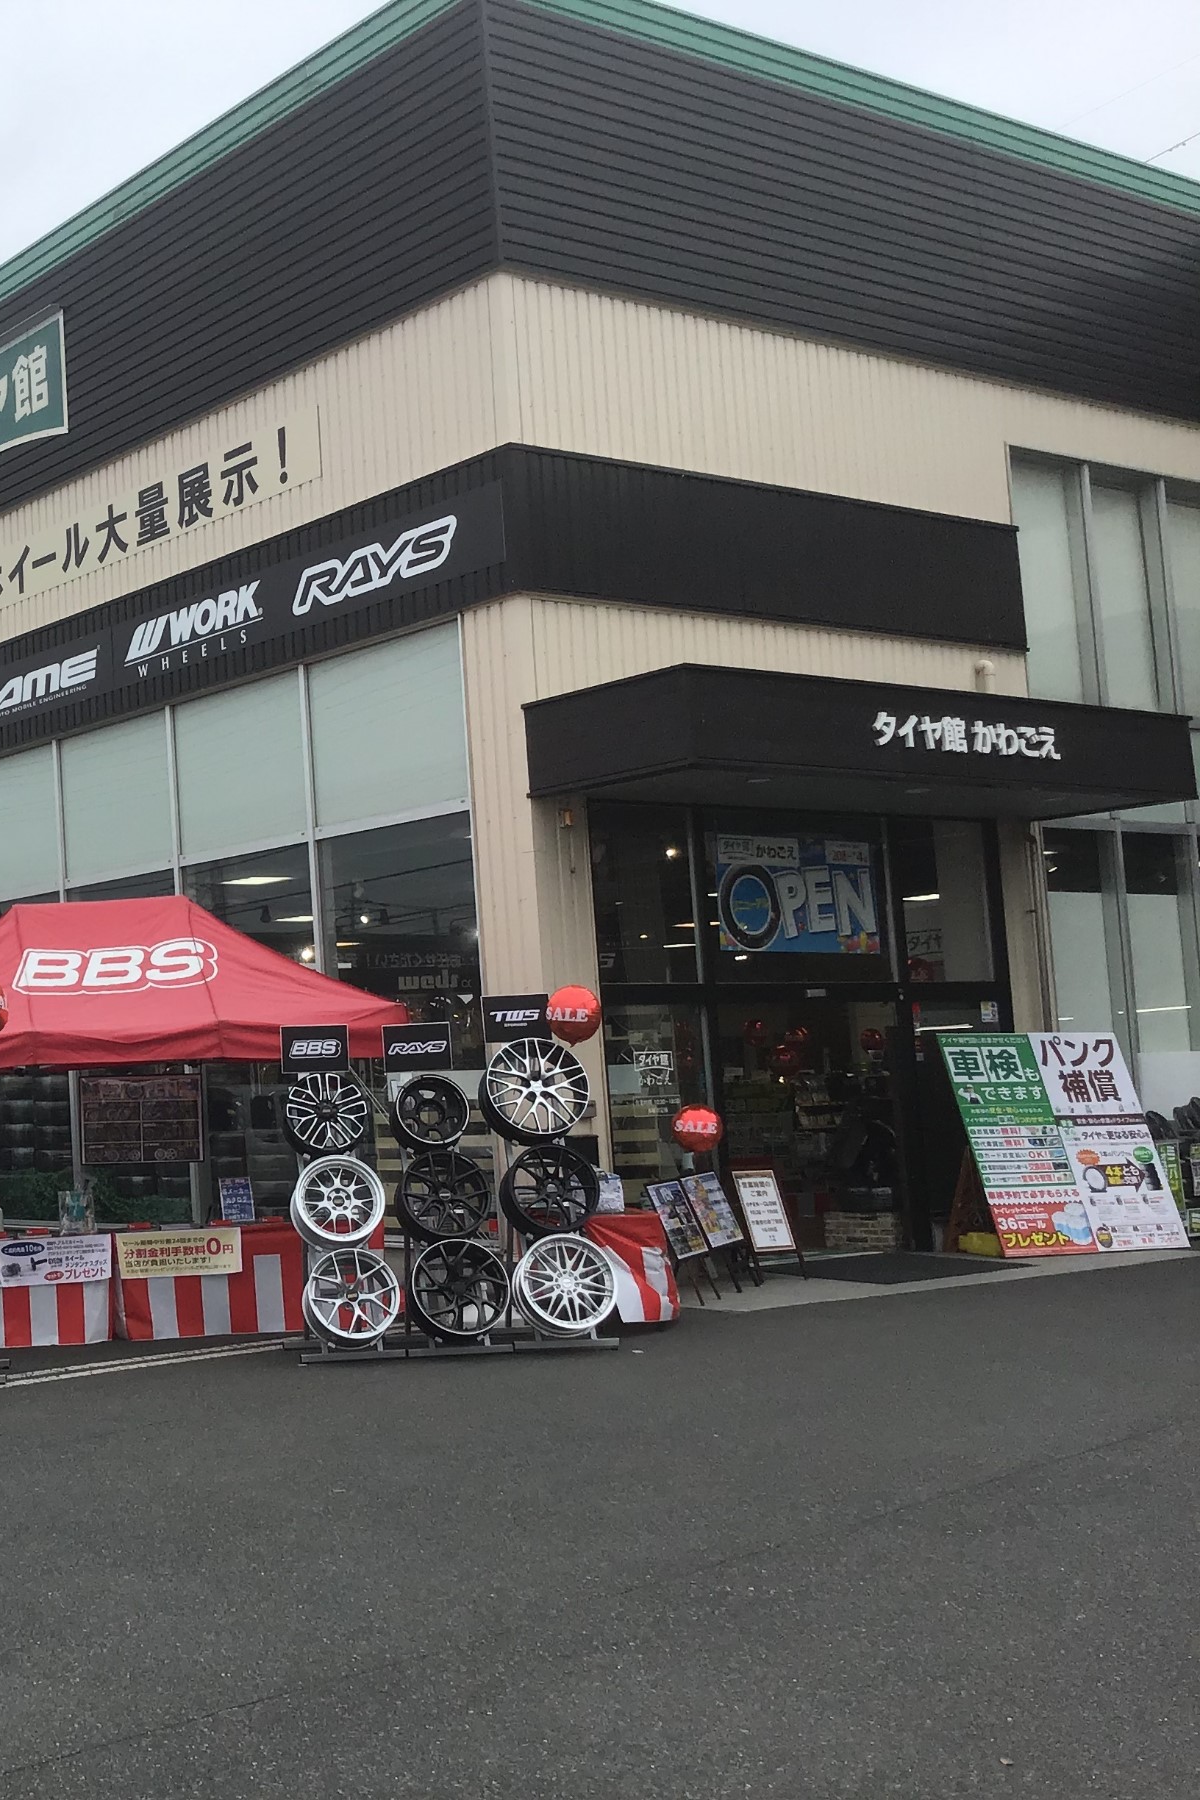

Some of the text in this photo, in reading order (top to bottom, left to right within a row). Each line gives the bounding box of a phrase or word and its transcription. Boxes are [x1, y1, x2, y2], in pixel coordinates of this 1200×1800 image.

[292, 514, 457, 616] RAYS
[138, 629, 248, 678] WHEELS
[12, 701, 37, 715] MOBILE
[39, 684, 87, 707] ENGINEERING
[872, 711, 1062, 761] タイヤ館 かわごえ
[755, 844, 797, 860] かわごえ
[719, 862, 877, 951] OPEN
[14, 938, 218, 996] BBS
[489, 1009, 540, 1023] TWS
[545, 1006, 589, 1023] SALE
[290, 1039, 341, 1059] BBS
[388, 1041, 448, 1056] RAYS
[1039, 1036, 1115, 1068] パンク
[948, 1049, 1040, 1082] 車検も
[980, 1086, 1043, 1101] できます
[1058, 1069, 1122, 1103] 補償
[674, 1120, 718, 1134] SALE
[1105, 1165, 1140, 1177] 4本とも
[997, 1217, 1047, 1230] 36ロール
[1003, 1232, 1070, 1248] プレゼント
[64, 1267, 107, 1280] プレゼント
